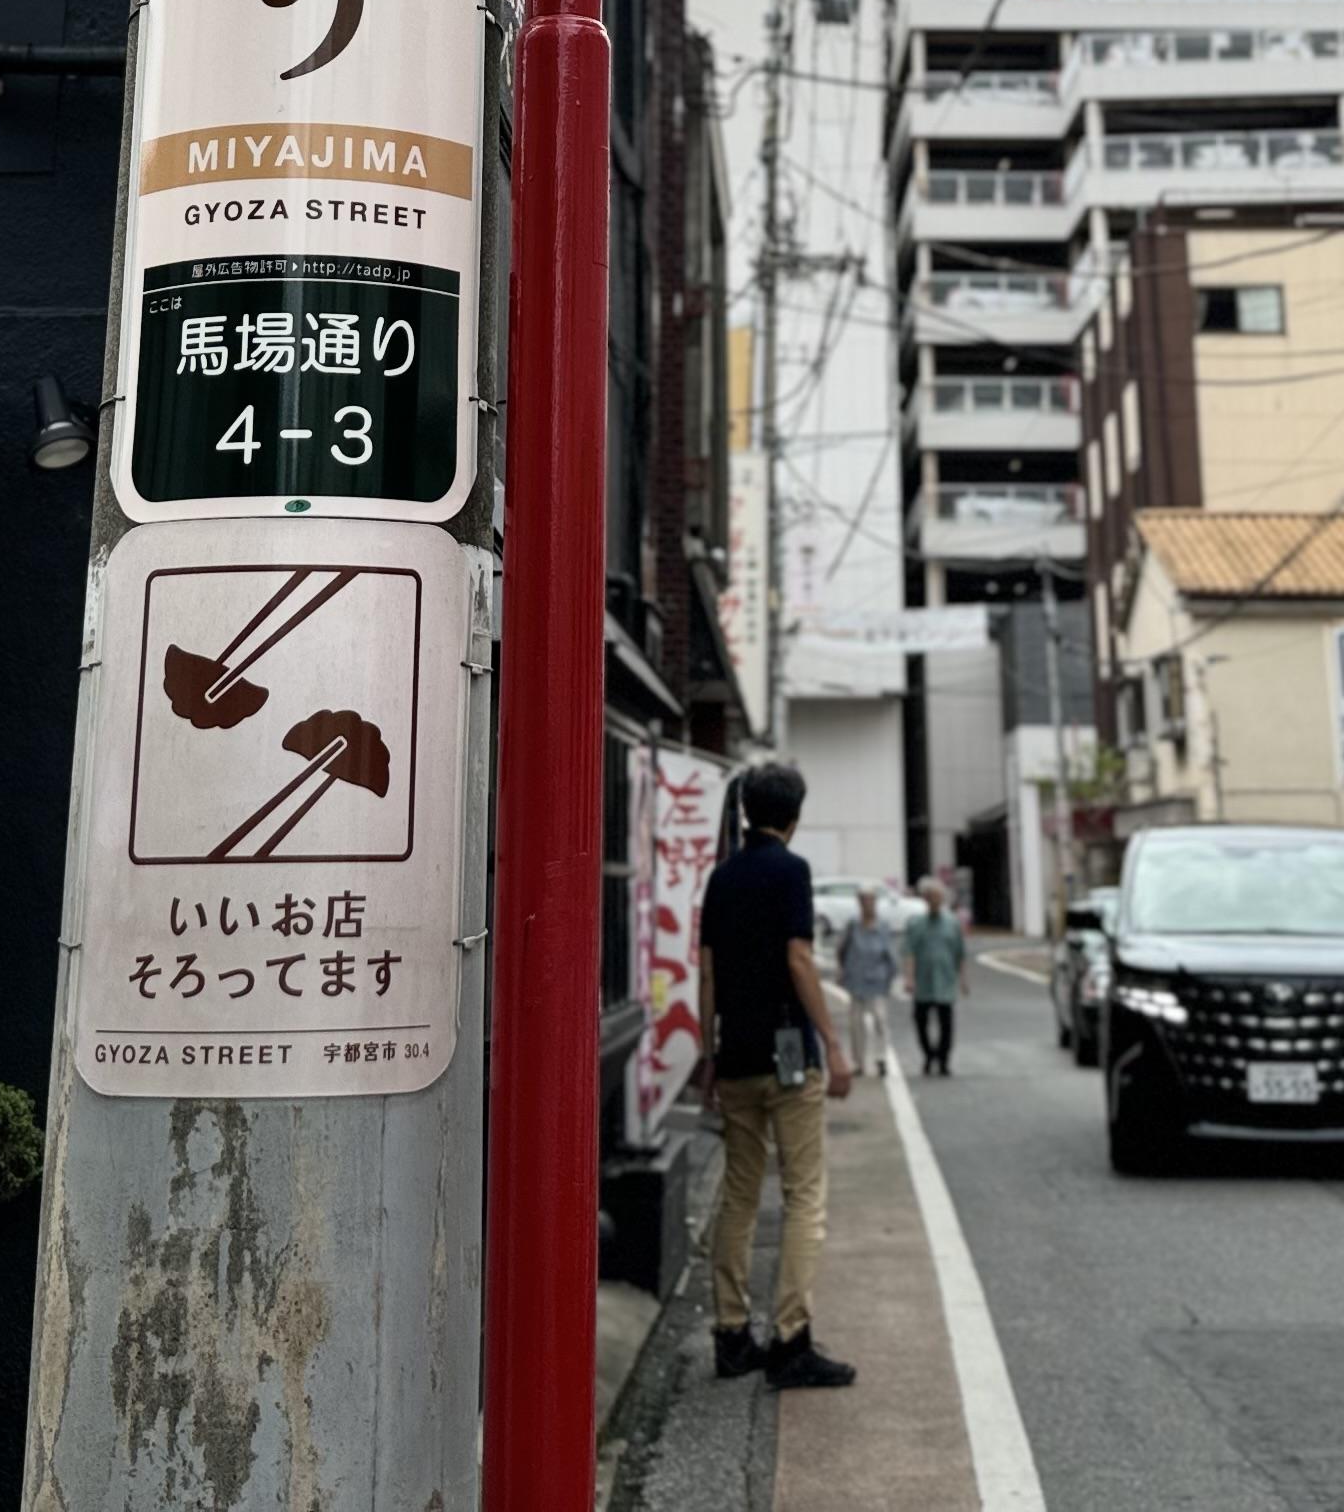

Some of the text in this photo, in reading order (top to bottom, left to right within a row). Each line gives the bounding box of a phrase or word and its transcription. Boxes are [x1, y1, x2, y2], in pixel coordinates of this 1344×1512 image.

[187, 135, 428, 179] MIYAJIMA
[184, 199, 428, 230] GYOZA STREET
[191, 259, 411, 282] 屋外広告物許可 http://tadp.jp
[148, 295, 183, 314] ここは
[176, 312, 416, 378] 馬場通り
[169, 889, 367, 939] いいお店
[128, 949, 403, 1000] そろってます
[95, 1039, 431, 1065] GYOZA STREET 宇都宮市 30.4
